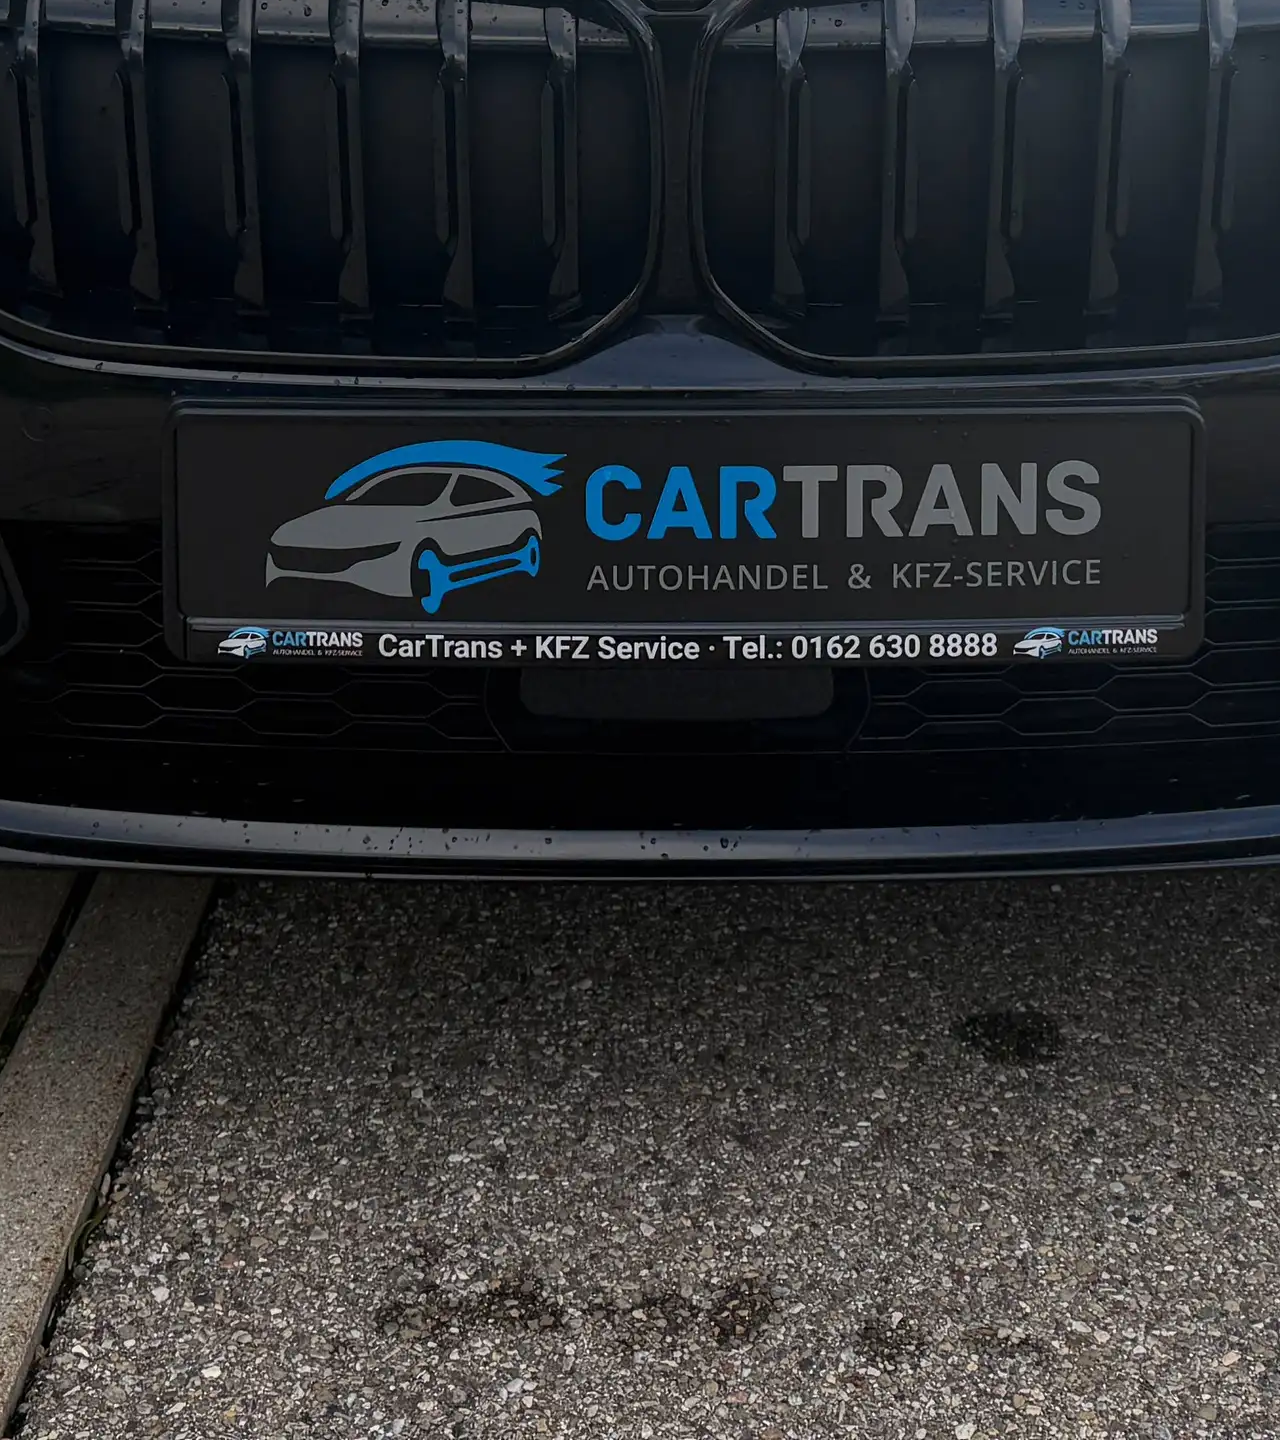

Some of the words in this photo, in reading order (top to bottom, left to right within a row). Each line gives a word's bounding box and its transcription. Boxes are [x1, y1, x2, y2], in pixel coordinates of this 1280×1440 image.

[584, 460, 1102, 542] CARTRANS
[586, 563, 828, 592] AUTOHANDEL
[847, 563, 871, 590] &
[892, 559, 1102, 589] KFZ-SERVICE
[272, 631, 363, 647] CARTRANS
[378, 633, 503, 658] CarTrans
[510, 639, 528, 657] +
[535, 635, 590, 659] KFZ
[597, 635, 700, 660] Service
[722, 634, 783, 659] Tel.:
[791, 634, 861, 659] 0162
[868, 634, 921, 658] 630
[928, 632, 998, 658] 8888
[1068, 629, 1158, 645] CARTRANS
